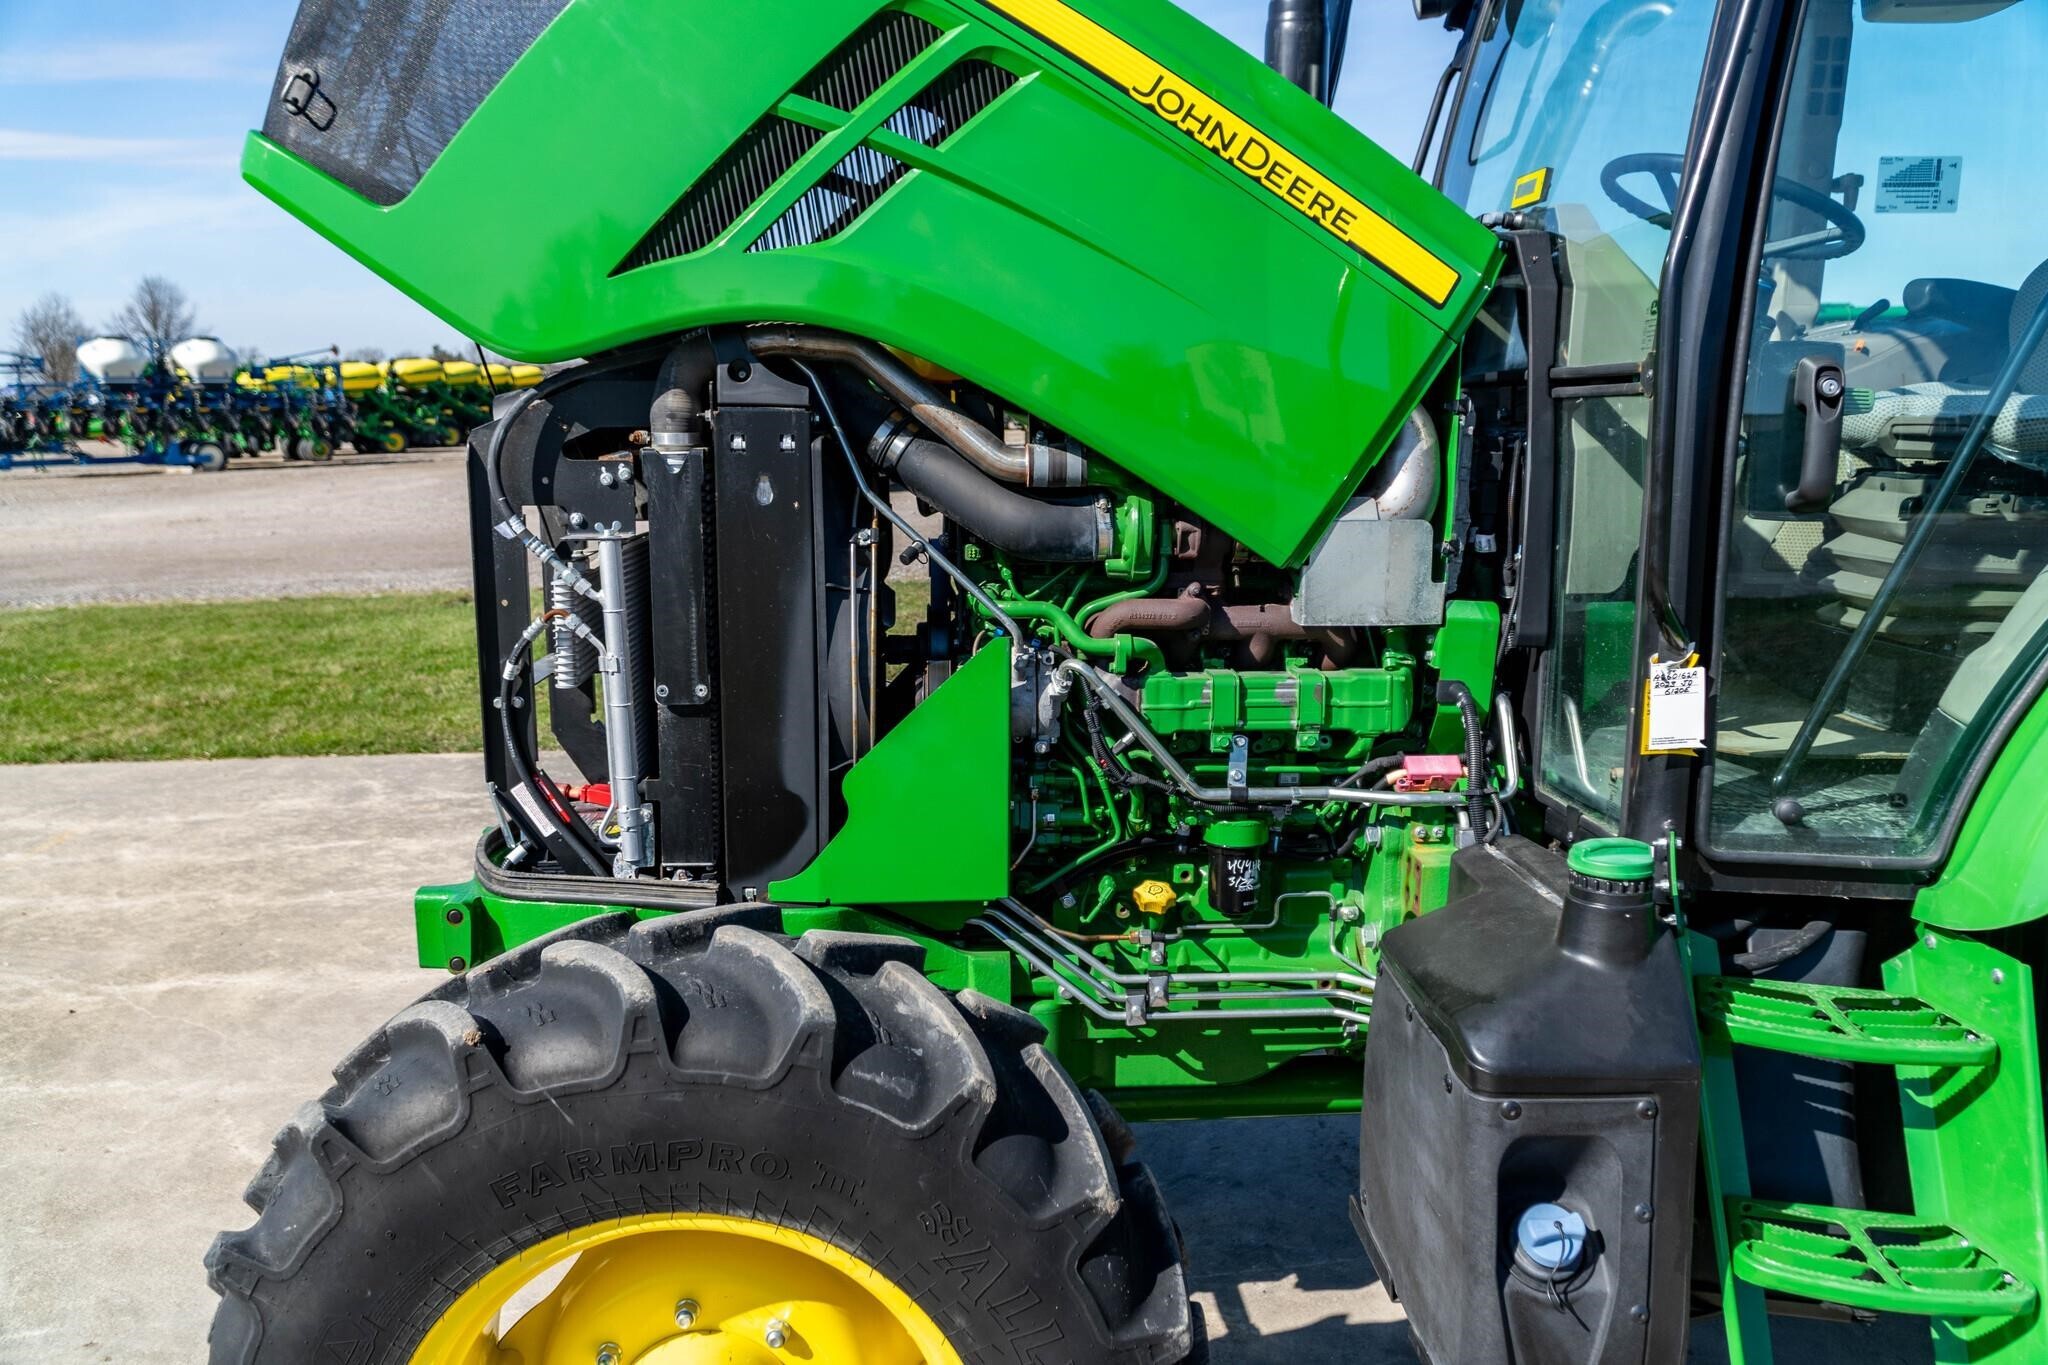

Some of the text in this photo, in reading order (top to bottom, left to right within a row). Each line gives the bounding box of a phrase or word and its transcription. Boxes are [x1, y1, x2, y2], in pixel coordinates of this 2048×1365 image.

[1132, 74, 1358, 236] JOHN DEERE
[487, 1139, 792, 1210] FARMPRO
[930, 1240, 1076, 1365] ALL
